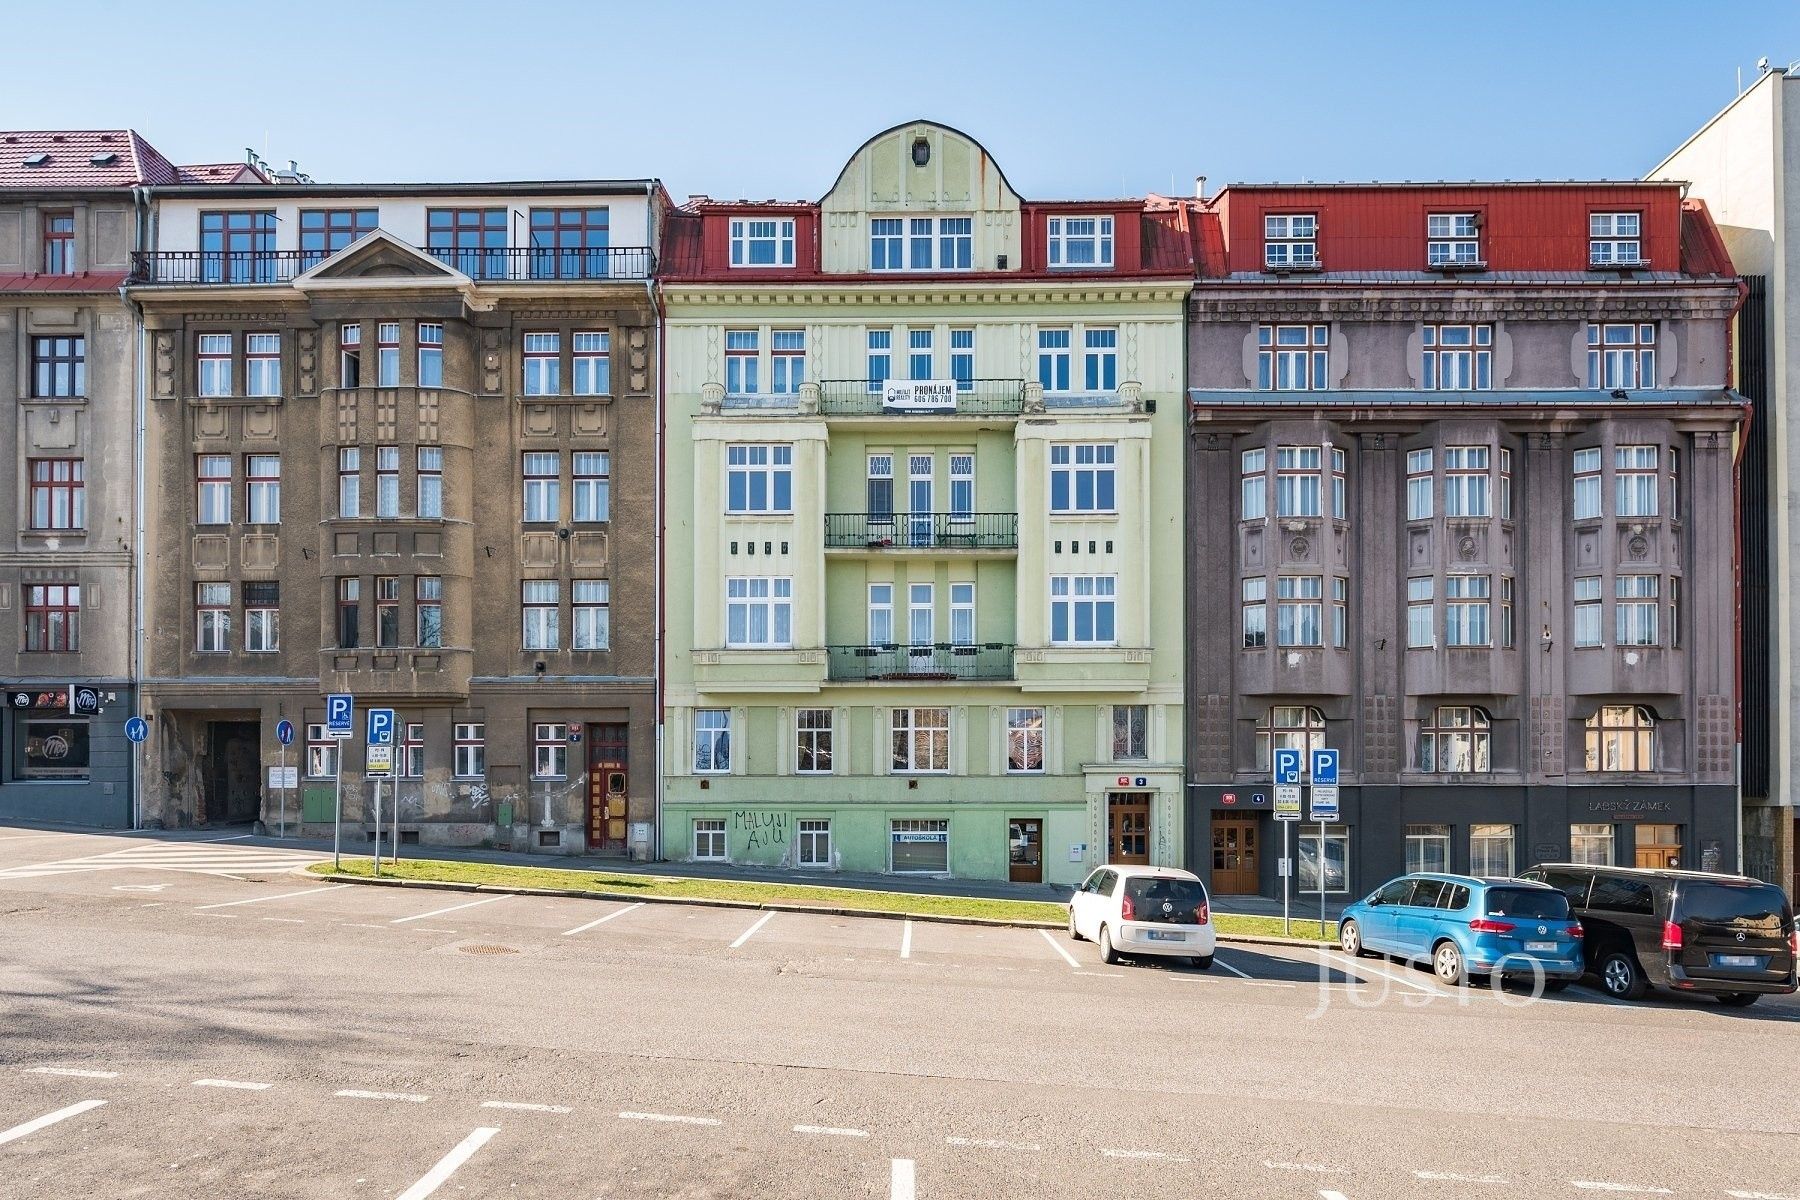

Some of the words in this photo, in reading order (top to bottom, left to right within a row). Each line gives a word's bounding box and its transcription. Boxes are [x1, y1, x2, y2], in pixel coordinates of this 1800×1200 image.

[914, 384, 952, 395] PRONÁJEM
[332, 699, 347, 720] P
[373, 714, 388, 734] P
[1280, 753, 1295, 774] P
[1317, 754, 1333, 775] P
[1589, 799, 1632, 811] LABSKÝ
[1633, 799, 1671, 811] ZÁMEK
